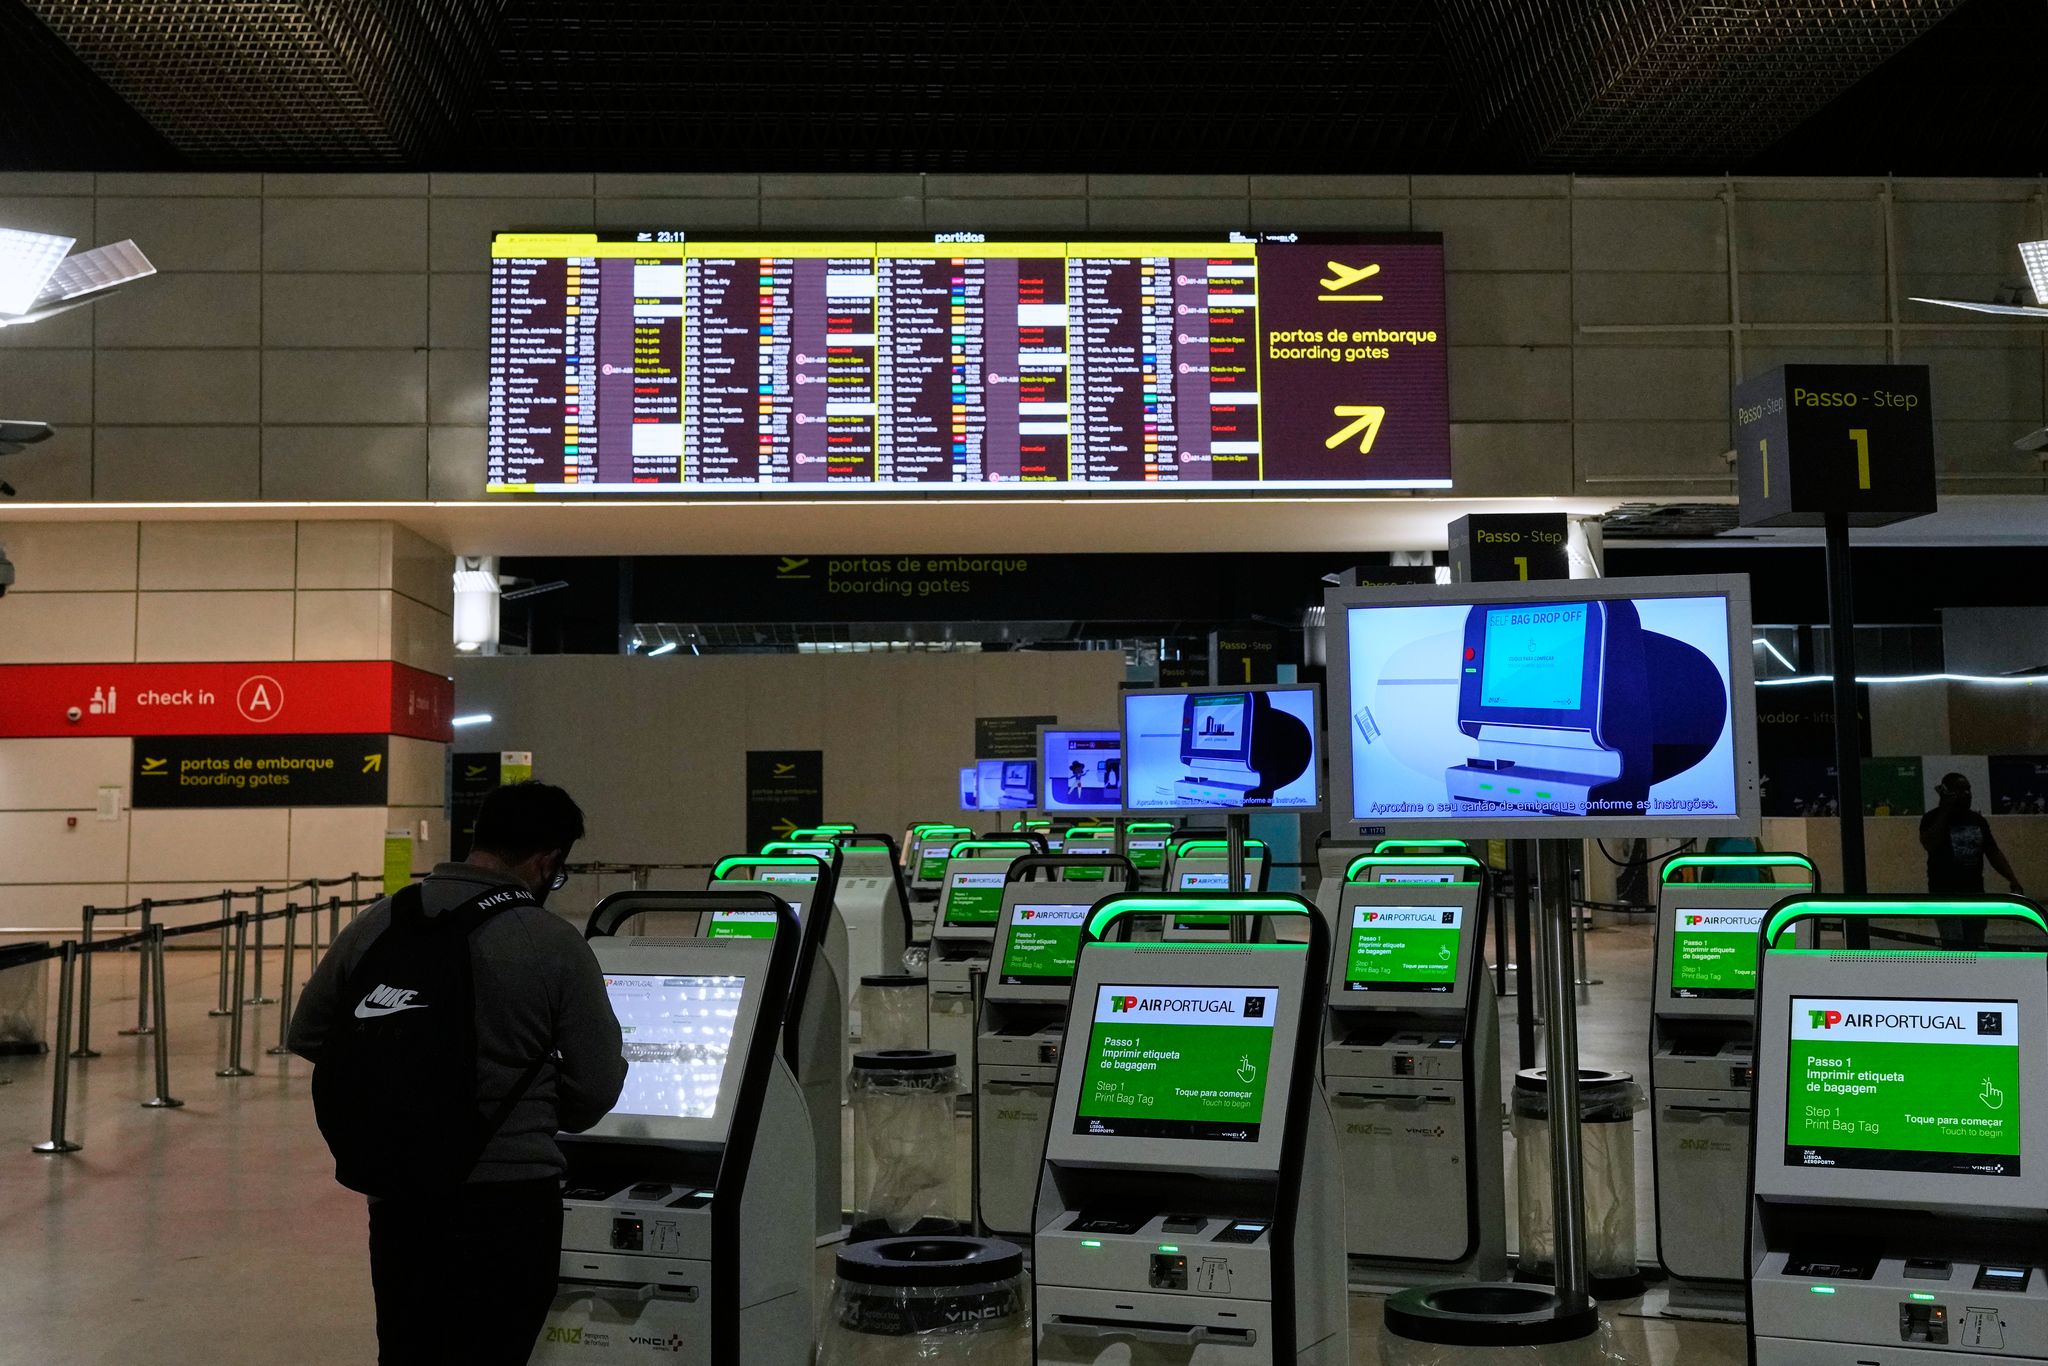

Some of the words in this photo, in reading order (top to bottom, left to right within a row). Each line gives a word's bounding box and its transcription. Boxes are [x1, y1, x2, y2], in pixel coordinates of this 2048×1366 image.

[657, 231, 685, 243] 23:11
[935, 231, 985, 243] partidas
[1270, 330, 1323, 345] portas
[1328, 329, 1347, 342] de
[1352, 329, 1437, 345] embarque
[1270, 346, 1340, 362] boarding
[1345, 346, 1389, 362] gates
[1794, 388, 1857, 407] Passo
[1874, 391, 1918, 411] Step
[1739, 406, 1762, 426] Passo
[1767, 397, 1784, 415] Step
[1849, 429, 1871, 489] 1
[1760, 439, 1768, 498] 1
[1477, 530, 1520, 543] Passo
[1532, 530, 1562, 544] Step
[828, 560, 892, 576] portas
[897, 558, 920, 572] de
[927, 558, 1027, 576] embarque
[828, 579, 913, 596] boarding
[918, 580, 970, 596] gates
[1490, 616, 1508, 626] SELF
[1511, 614, 1530, 625] BAG
[1533, 613, 1560, 623] DROP
[1563, 611, 1582, 622] OFF
[1220, 641, 1247, 650] Passo
[137, 690, 192, 706] check
[199, 690, 214, 705] in
[250, 684, 270, 711] A
[180, 756, 230, 772] portas
[235, 755, 252, 770] de
[257, 755, 334, 774] embarque
[180, 772, 245, 788] boarding
[249, 772, 289, 788] gates
[1370, 801, 1423, 815] Aproxime
[1426, 804, 1434, 812] o
[1437, 804, 1458, 812] seu
[1461, 801, 1496, 812] cartão
[1499, 801, 1514, 811] de
[1517, 800, 1575, 814] embarque
[1578, 799, 1633, 811] conforme
[1653, 798, 1718, 813] instruções.
[478, 892, 512, 910] NIKE
[1021, 911, 1035, 919] TAP
[1362, 912, 1378, 922] TAP
[1685, 916, 1702, 925] TAP
[1704, 917, 1762, 925] AIRPORTUGA
[367, 983, 418, 1008] NIKE
[1111, 995, 1138, 1013] TAP
[1139, 998, 1235, 1013] AIRPORTUGAL
[1808, 1010, 1842, 1030] TAP
[1845, 1014, 1966, 1030] AIRPORTUGAL
[1104, 1037, 1132, 1047] Passo
[1135, 1038, 1139, 1046] 1
[1102, 1048, 1141, 1060] Imprimir
[1143, 1050, 1180, 1061] etiqueta
[1807, 1056, 1842, 1067] Passo
[1846, 1058, 1851, 1067] 1
[1101, 1060, 1112, 1069] de
[1114, 1061, 1156, 1071] bagagem
[1807, 1069, 1854, 1082] Imprimir
[1858, 1070, 1904, 1082] etiqueta
[1097, 1081, 1117, 1092] Step
[1121, 1082, 1124, 1090] 1
[1175, 1087, 1198, 1098] Toque
[1200, 1090, 1217, 1099] para
[1219, 1091, 1252, 1100] começar
[1806, 1083, 1820, 1092] de
[1824, 1083, 1876, 1095] bagagem
[1095, 1093, 1114, 1102] Print
[1117, 1094, 1134, 1105] Bag
[1138, 1094, 1154, 1106] Tag
[1232, 1100, 1250, 1108] begin
[1806, 1106, 1830, 1119] Step
[1835, 1107, 1840, 1116] 1
[1806, 1119, 1829, 1130] Print
[1833, 1120, 1854, 1133] Bag
[1858, 1121, 1879, 1133] Tag
[1905, 1114, 1934, 1125] Toque
[1937, 1117, 1958, 1126] para
[1961, 1117, 2003, 1128] começar
[1941, 1127, 1966, 1135] Touch
[1969, 1128, 1977, 1136] to
[1979, 1128, 2003, 1138] begin
[946, 1307, 1000, 1322] VINCI
[629, 1336, 665, 1346] VINCI
